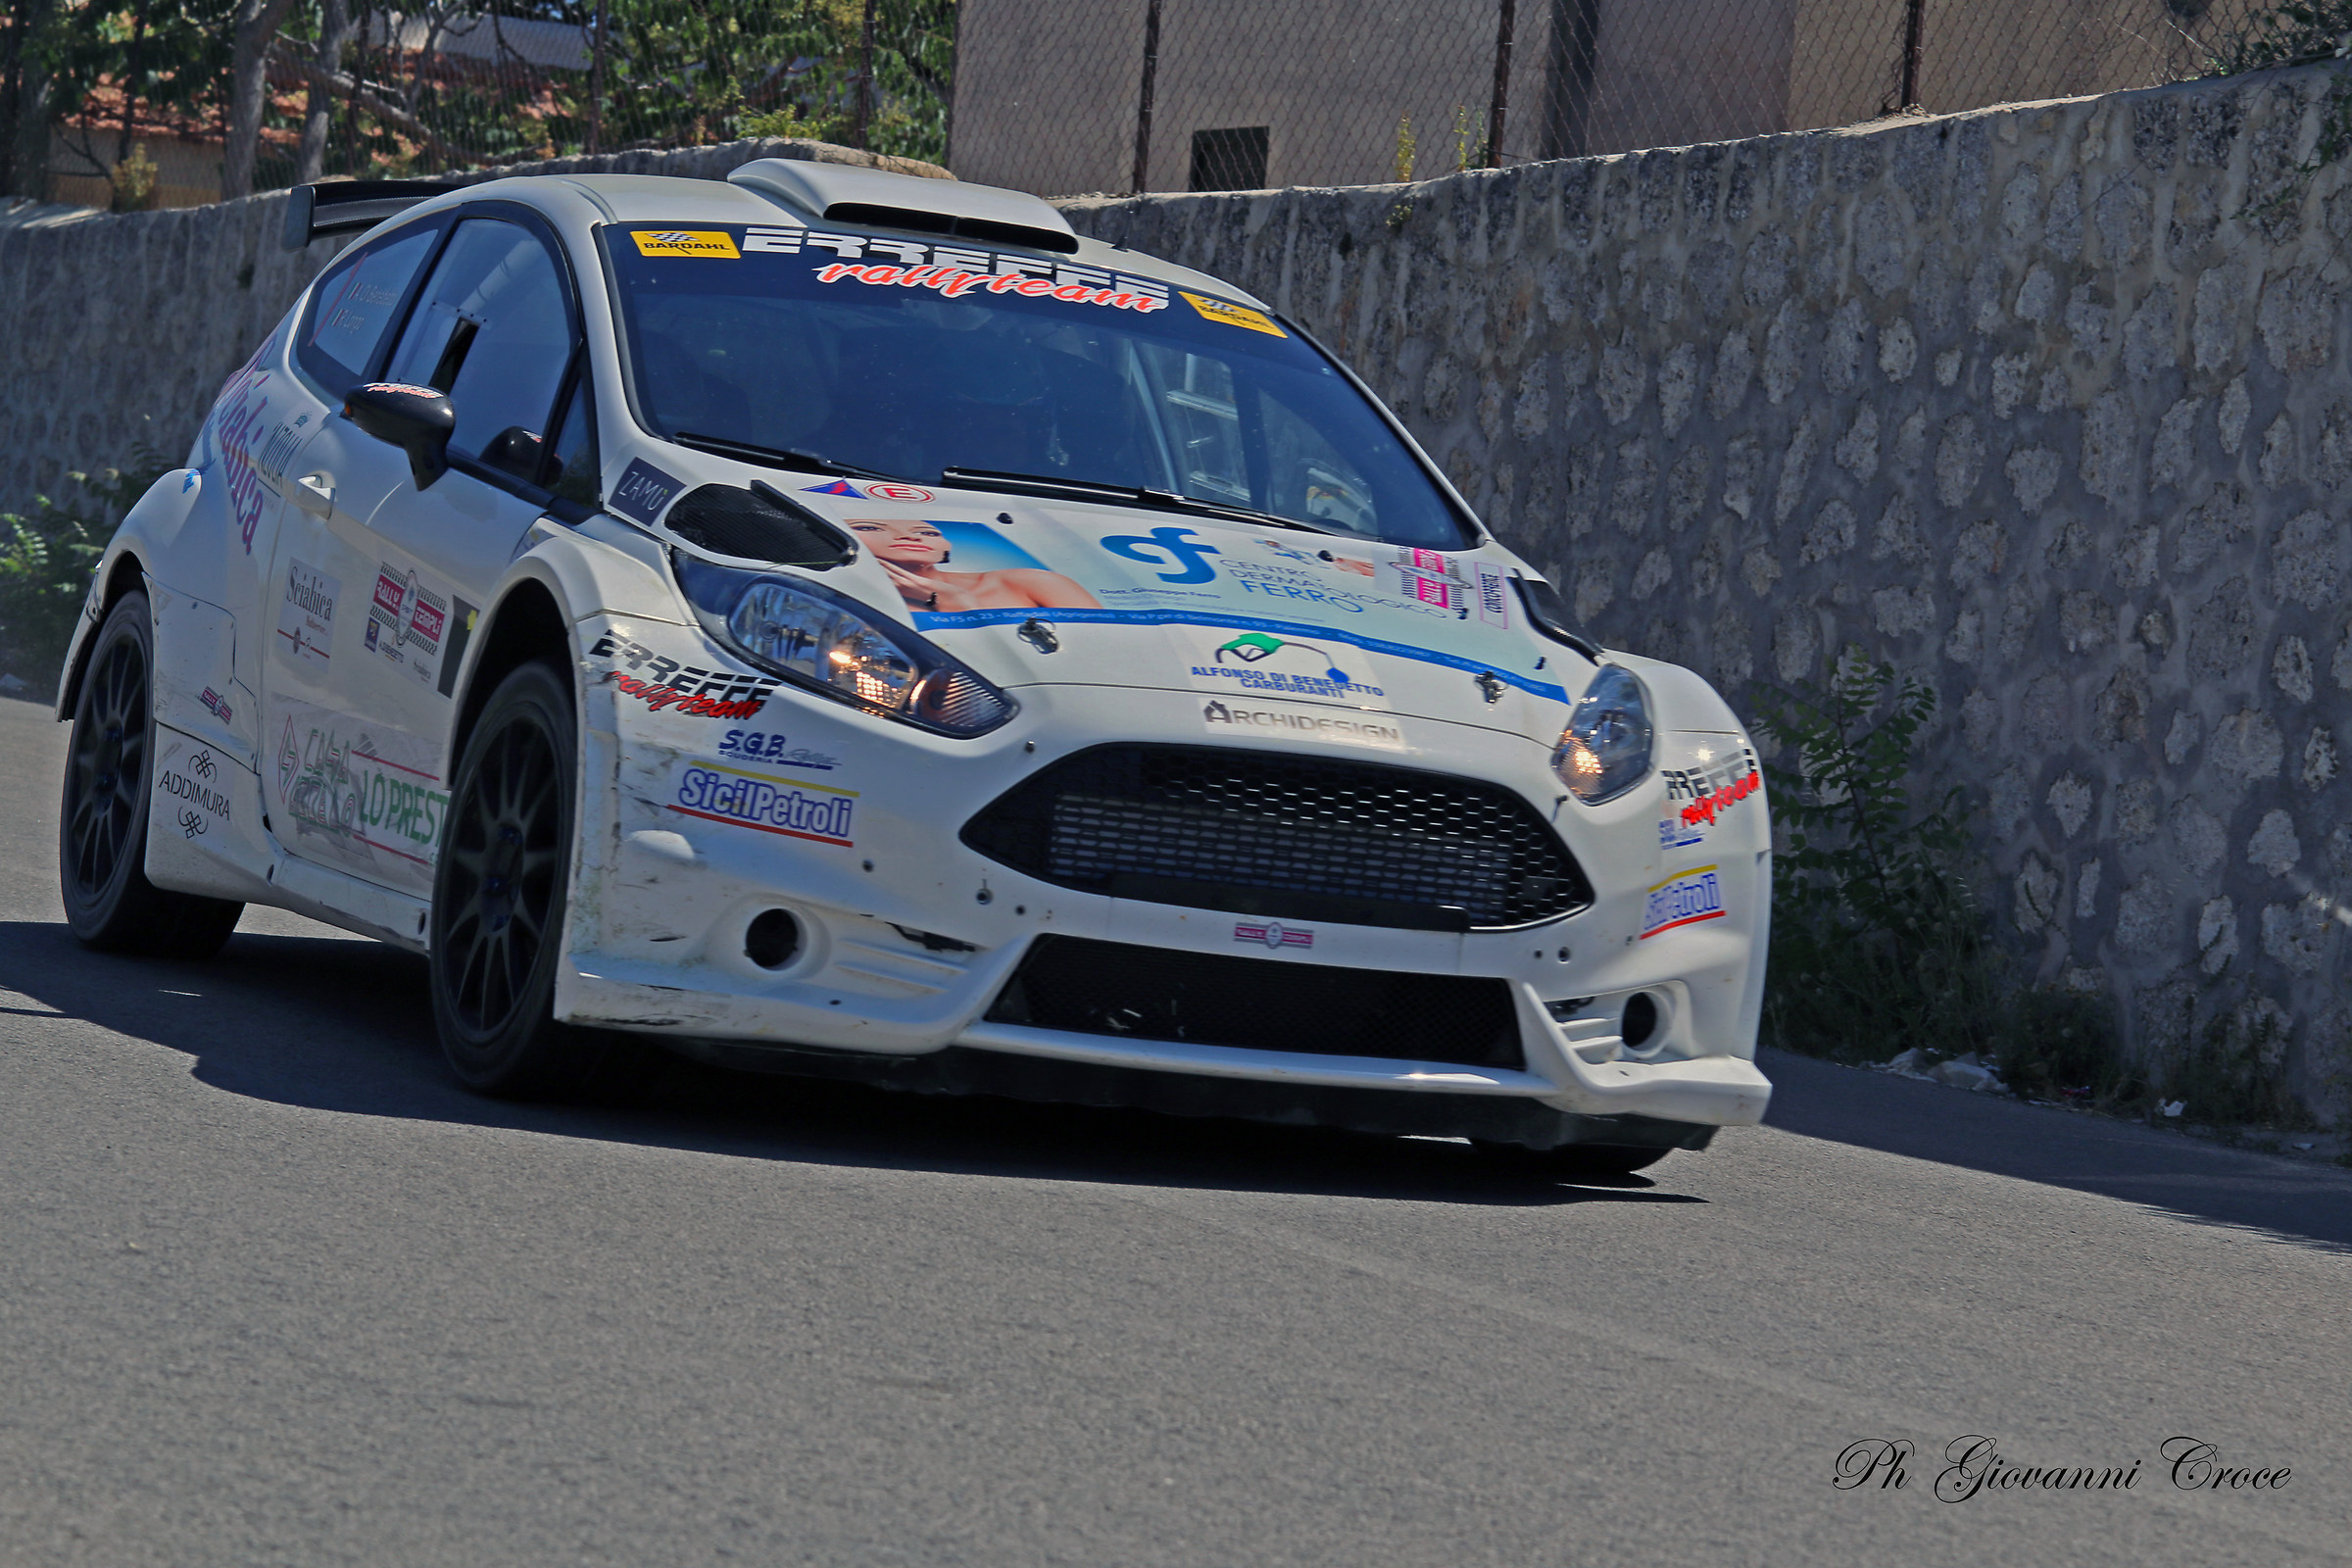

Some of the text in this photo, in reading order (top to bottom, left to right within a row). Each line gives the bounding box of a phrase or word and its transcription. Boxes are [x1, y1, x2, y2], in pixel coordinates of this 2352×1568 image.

[286, 565, 333, 622] Sciabica
[1240, 579, 1364, 613] FERRO
[1191, 666, 1384, 697] ALFONSO DI BENEDETTO
[1241, 677, 1345, 699] CARBURANTI
[1203, 700, 1399, 741] ARCHIDESIGN
[718, 750, 774, 763] SCUDERIA
[159, 770, 230, 821] ADDIMURA
[360, 769, 386, 826] LO
[678, 768, 853, 838] SicilPetroli
